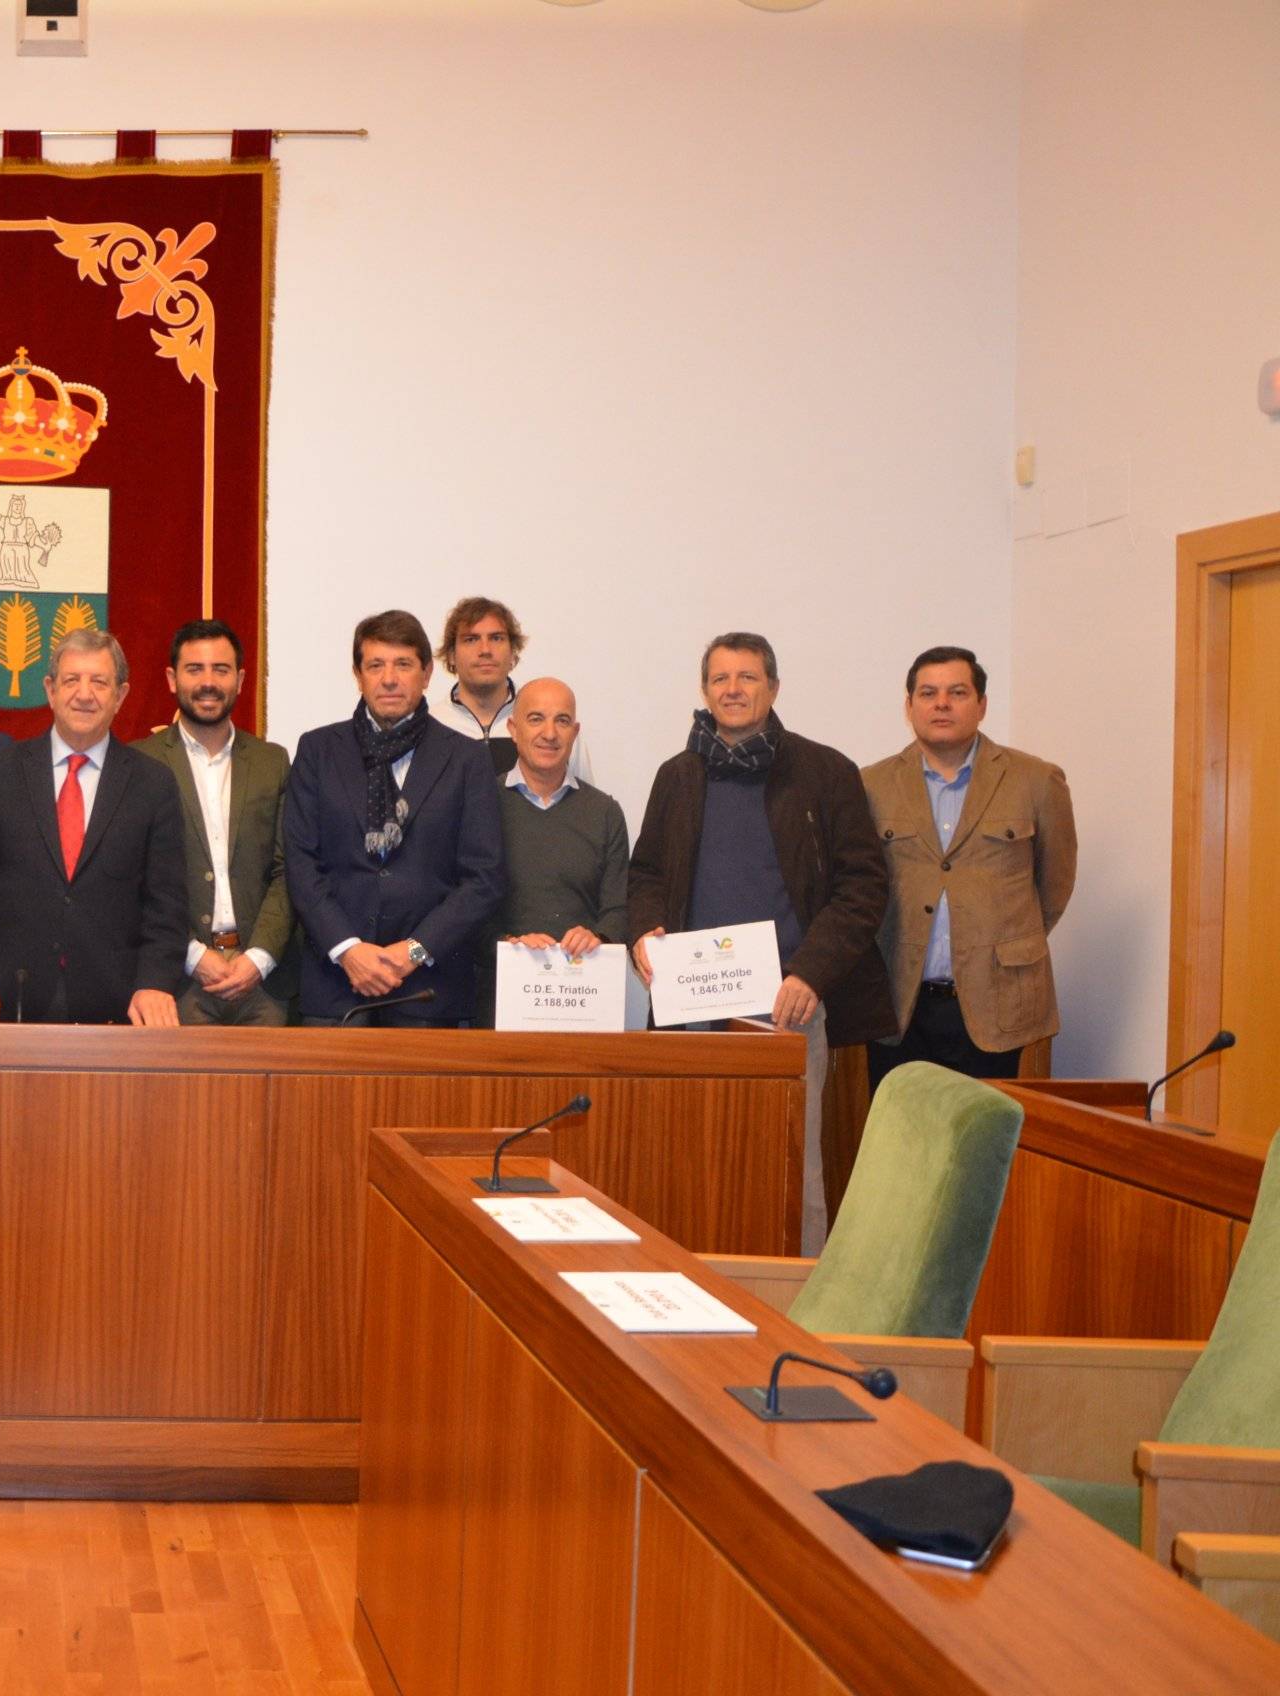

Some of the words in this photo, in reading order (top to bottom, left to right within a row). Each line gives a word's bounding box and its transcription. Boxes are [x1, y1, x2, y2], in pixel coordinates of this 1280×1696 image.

[677, 973, 718, 984] Colegio
[721, 968, 752, 979] Kolbe
[523, 984, 555, 994] C.D.E.
[558, 985, 598, 995] Triatlón
[736, 981, 743, 990] €
[534, 998, 577, 1008] 2.188,90
[580, 998, 587, 1008] €
